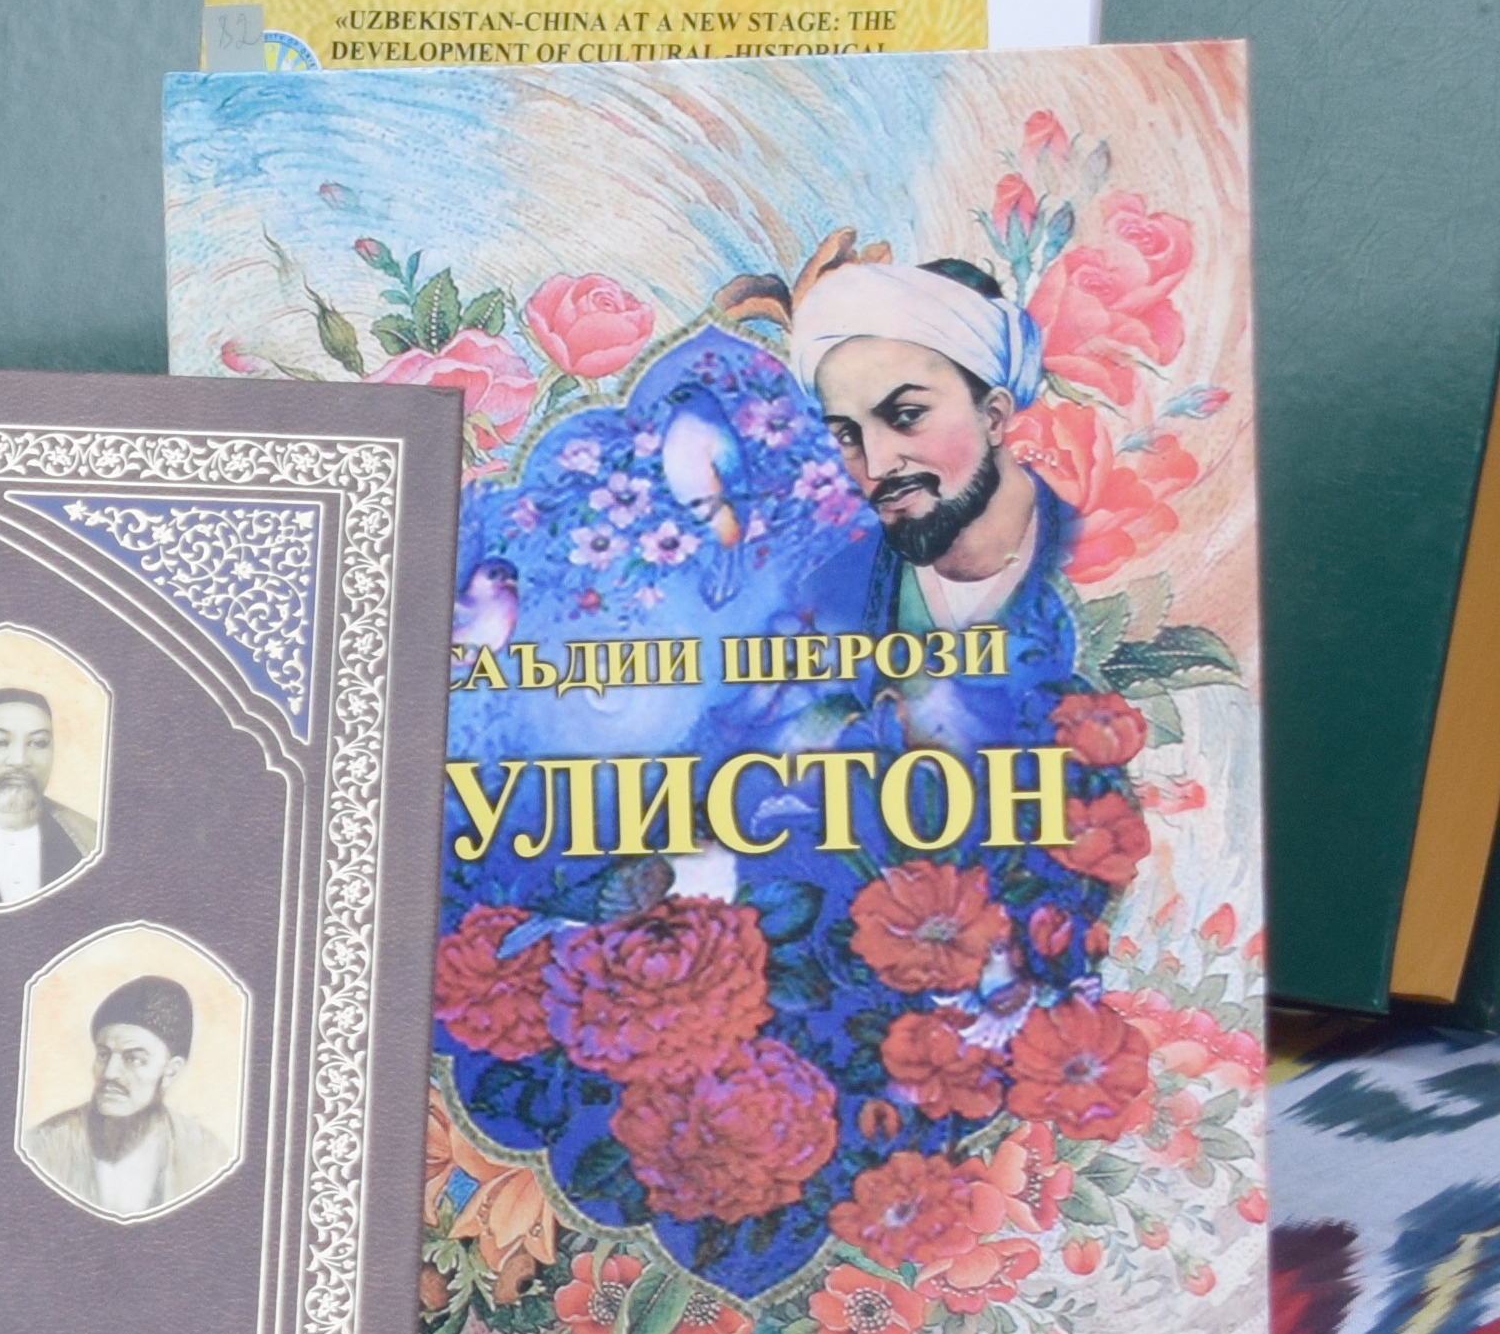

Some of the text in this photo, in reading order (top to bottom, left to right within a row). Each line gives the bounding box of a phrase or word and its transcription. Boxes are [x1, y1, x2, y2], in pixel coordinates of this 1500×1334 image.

[335, 10, 896, 33] «UZBEKISTAN-CHINA AT A NEW STAGE: THE
[331, 41, 529, 62] DEVELOPMENT
[536, 43, 571, 63] OF
[578, 43, 712, 62] CULTURAL
[445, 744, 1076, 861] УЛИСТОН
